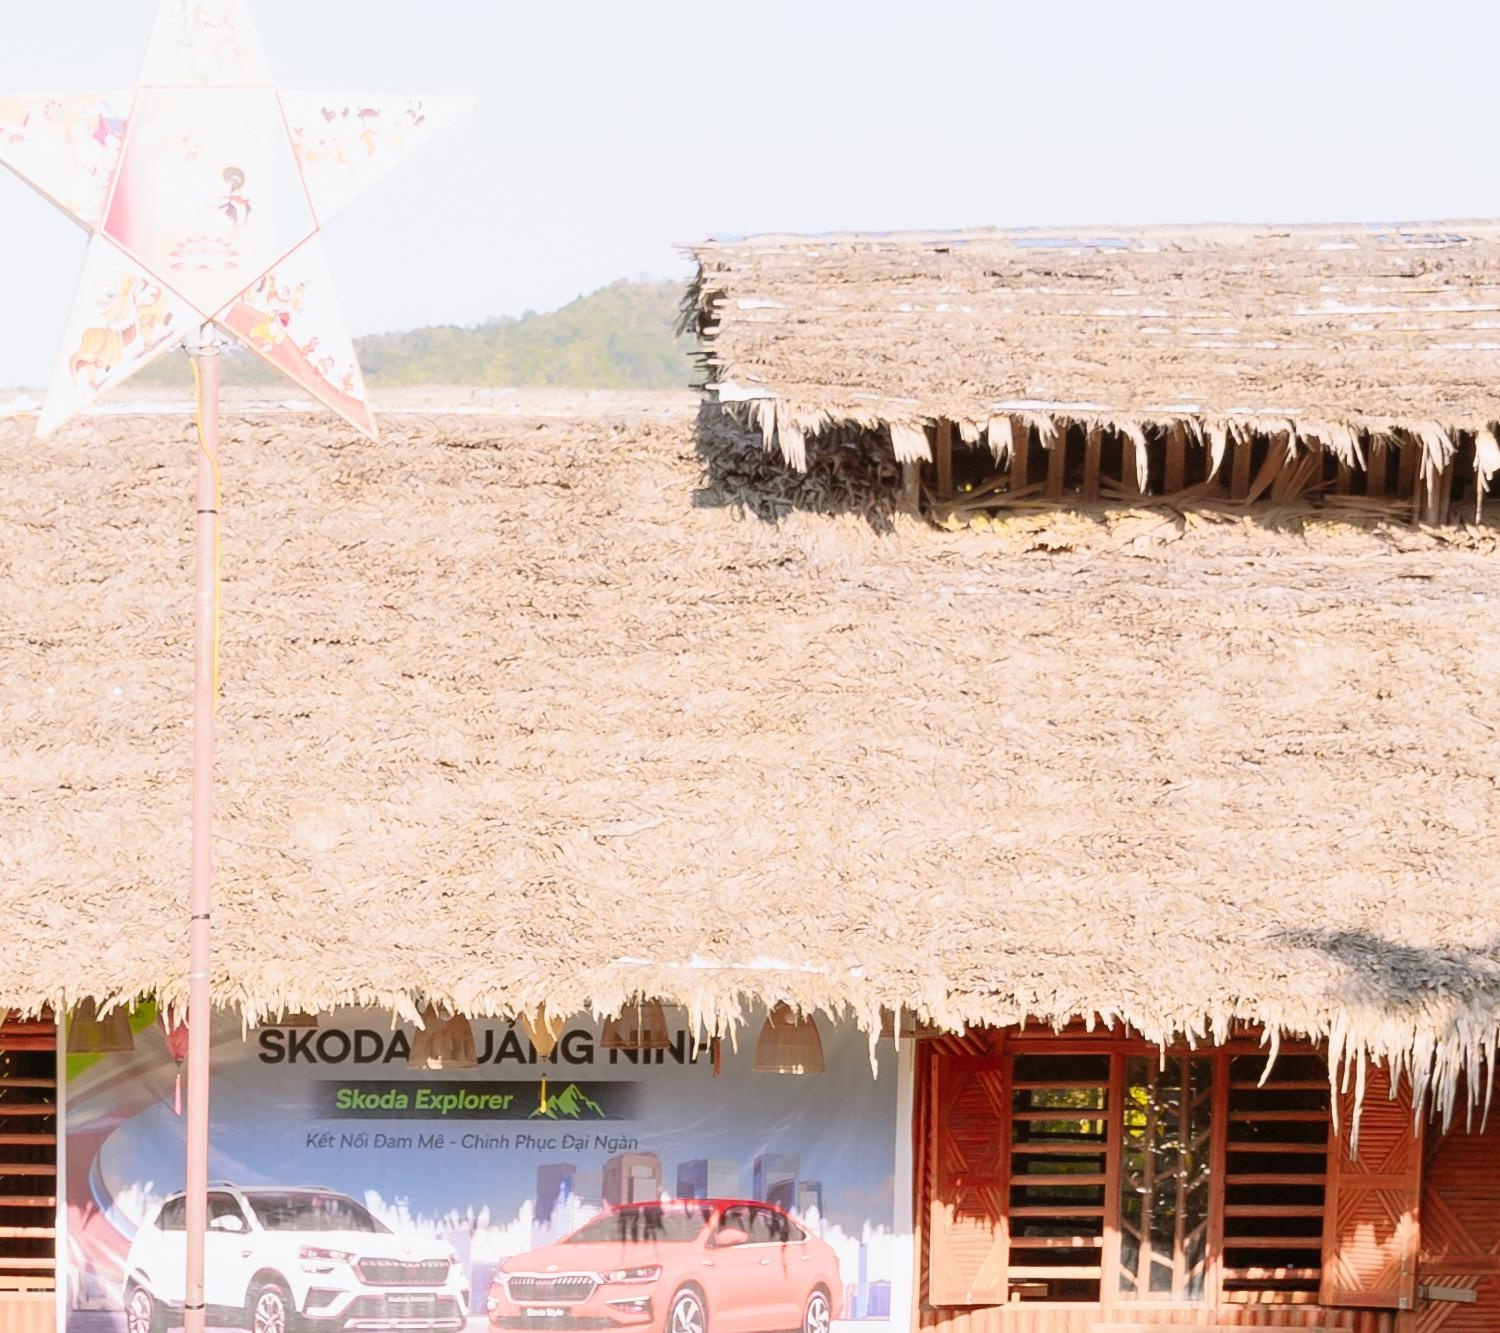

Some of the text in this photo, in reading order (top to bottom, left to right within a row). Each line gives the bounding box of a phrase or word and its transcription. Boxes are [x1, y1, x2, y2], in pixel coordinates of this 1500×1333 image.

[258, 1029, 411, 1064] SKODA
[336, 1088, 514, 1115] Skoda Explorer
[305, 1132, 335, 1149] Kết
[340, 1131, 370, 1149] Nối
[374, 1133, 413, 1149] Đam
[418, 1133, 444, 1149] Mê
[514, 1135, 557, 1152] Phục
[561, 1134, 591, 1152] Đại
[594, 1135, 639, 1153] Ngàn
